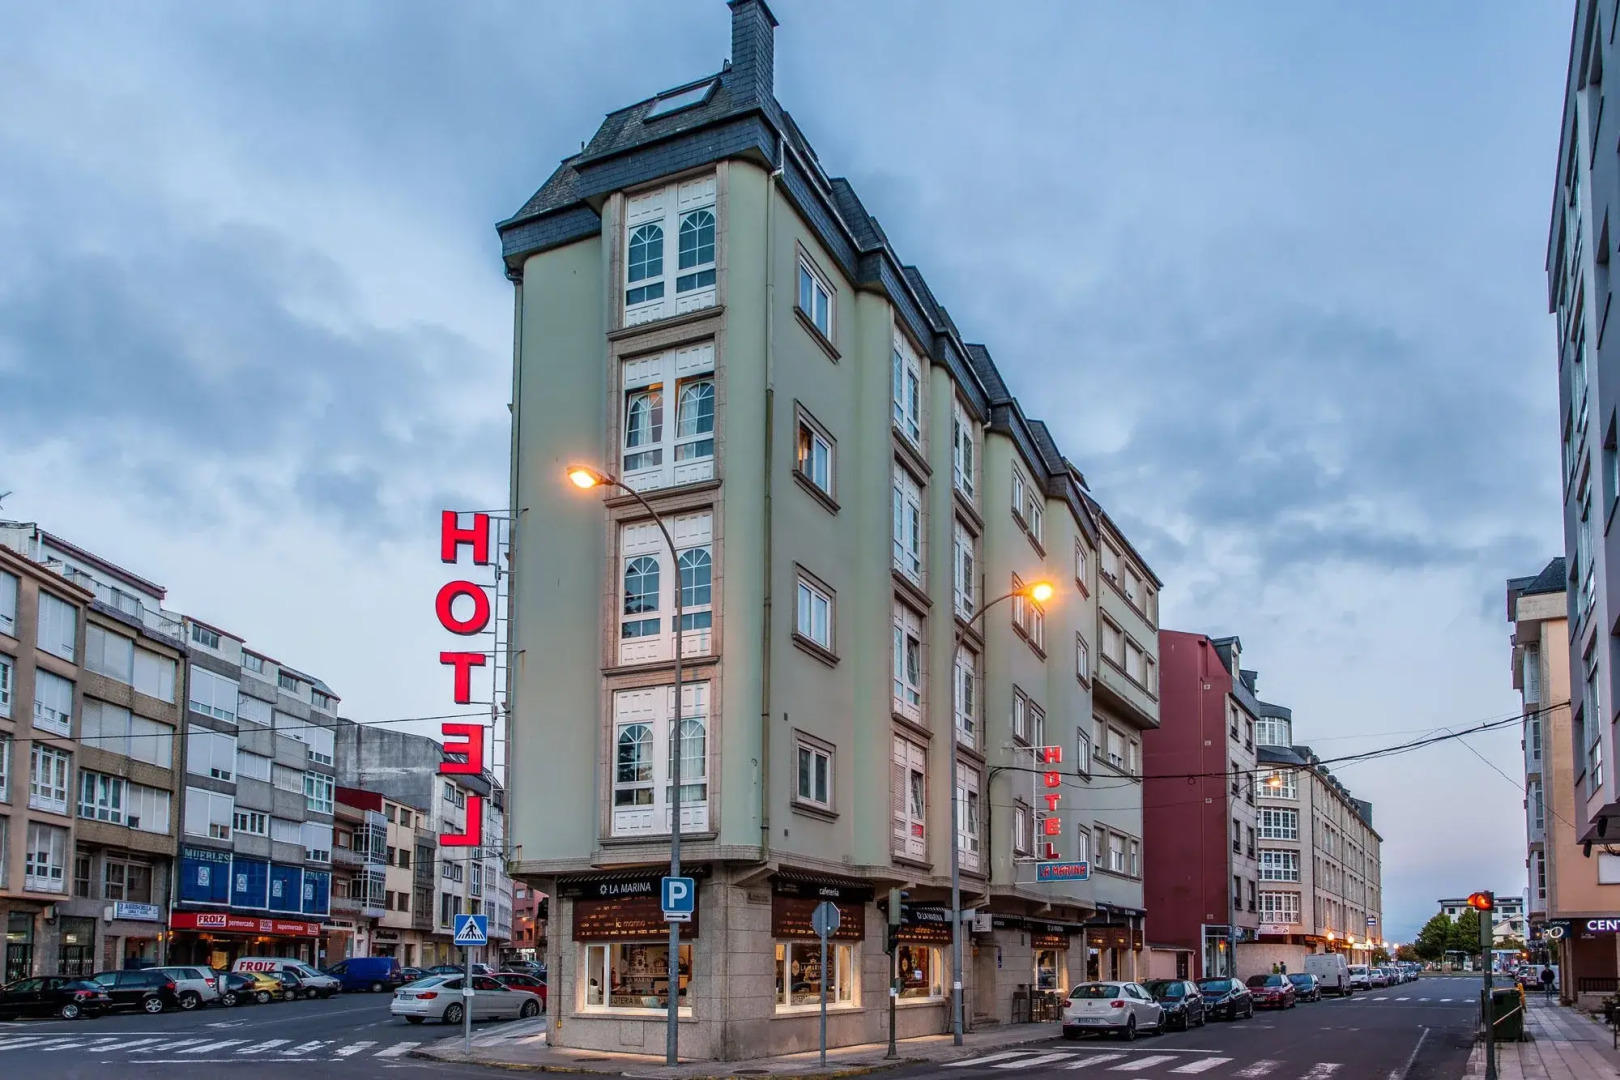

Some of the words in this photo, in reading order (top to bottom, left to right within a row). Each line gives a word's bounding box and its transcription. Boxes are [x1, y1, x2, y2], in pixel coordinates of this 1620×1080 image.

[1044, 745, 1062, 859] HOTEL
[184, 848, 230, 864] MUEBLES
[1040, 866, 1049, 877] LA
[1052, 865, 1086, 877] MARINA
[609, 885, 619, 894] LA
[620, 882, 652, 893] MARINA
[668, 881, 688, 908] P
[198, 915, 225, 923] FROIZ
[239, 961, 277, 972] FROIZ
